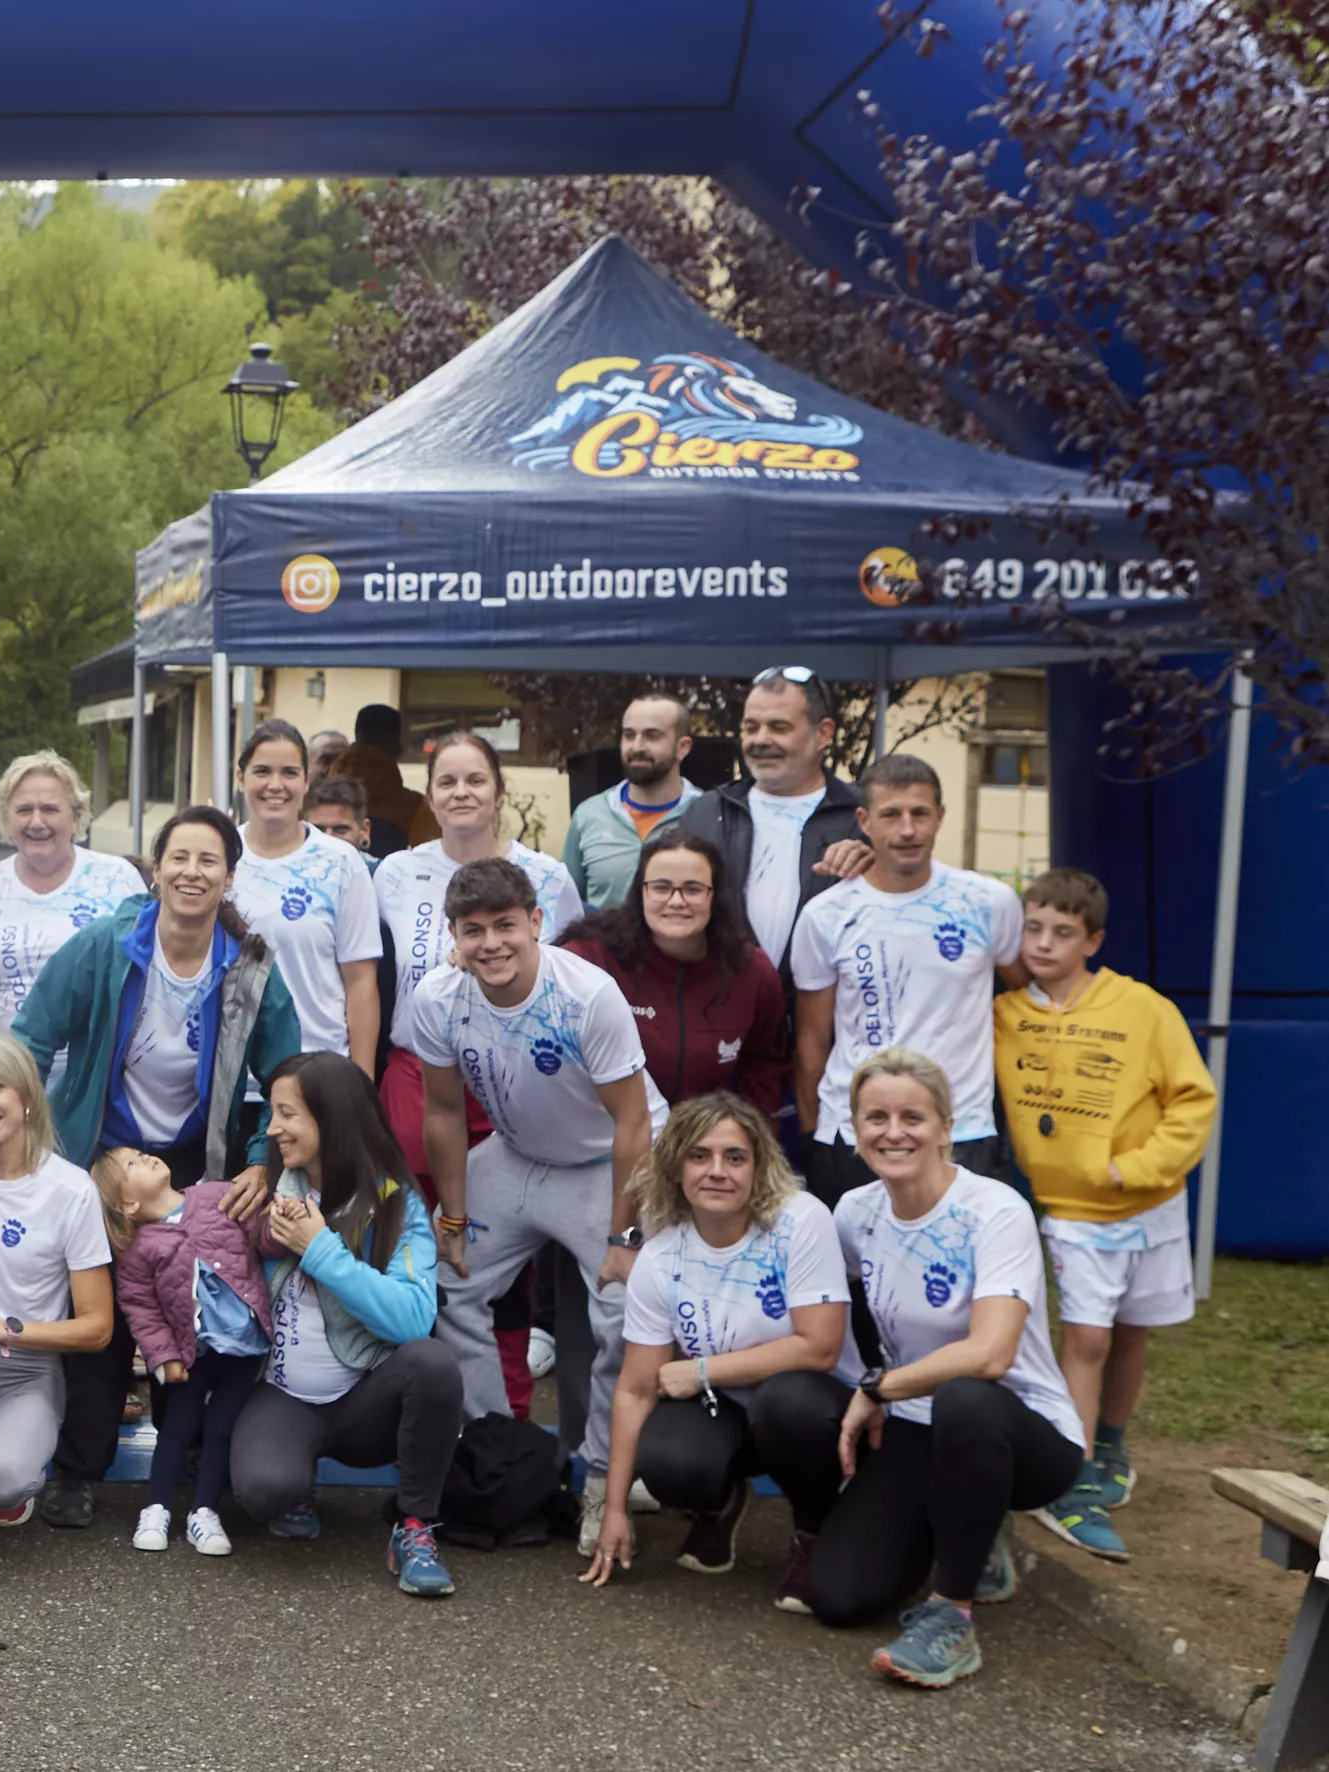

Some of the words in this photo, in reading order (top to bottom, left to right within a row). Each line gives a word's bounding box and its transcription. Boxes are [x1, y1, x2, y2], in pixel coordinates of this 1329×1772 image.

[572, 411, 859, 477] Cierzo
[649, 466, 758, 478] OUTDOOR
[765, 468, 860, 481] EVENTS
[364, 558, 788, 607] cierzo_outdoorevents
[942, 558, 1023, 599] 649
[1033, 559, 1108, 599] 201
[412, 902, 432, 986] ELONSO
[856, 944, 882, 1046] DELONSO
[273, 1331, 288, 1388] PASO
